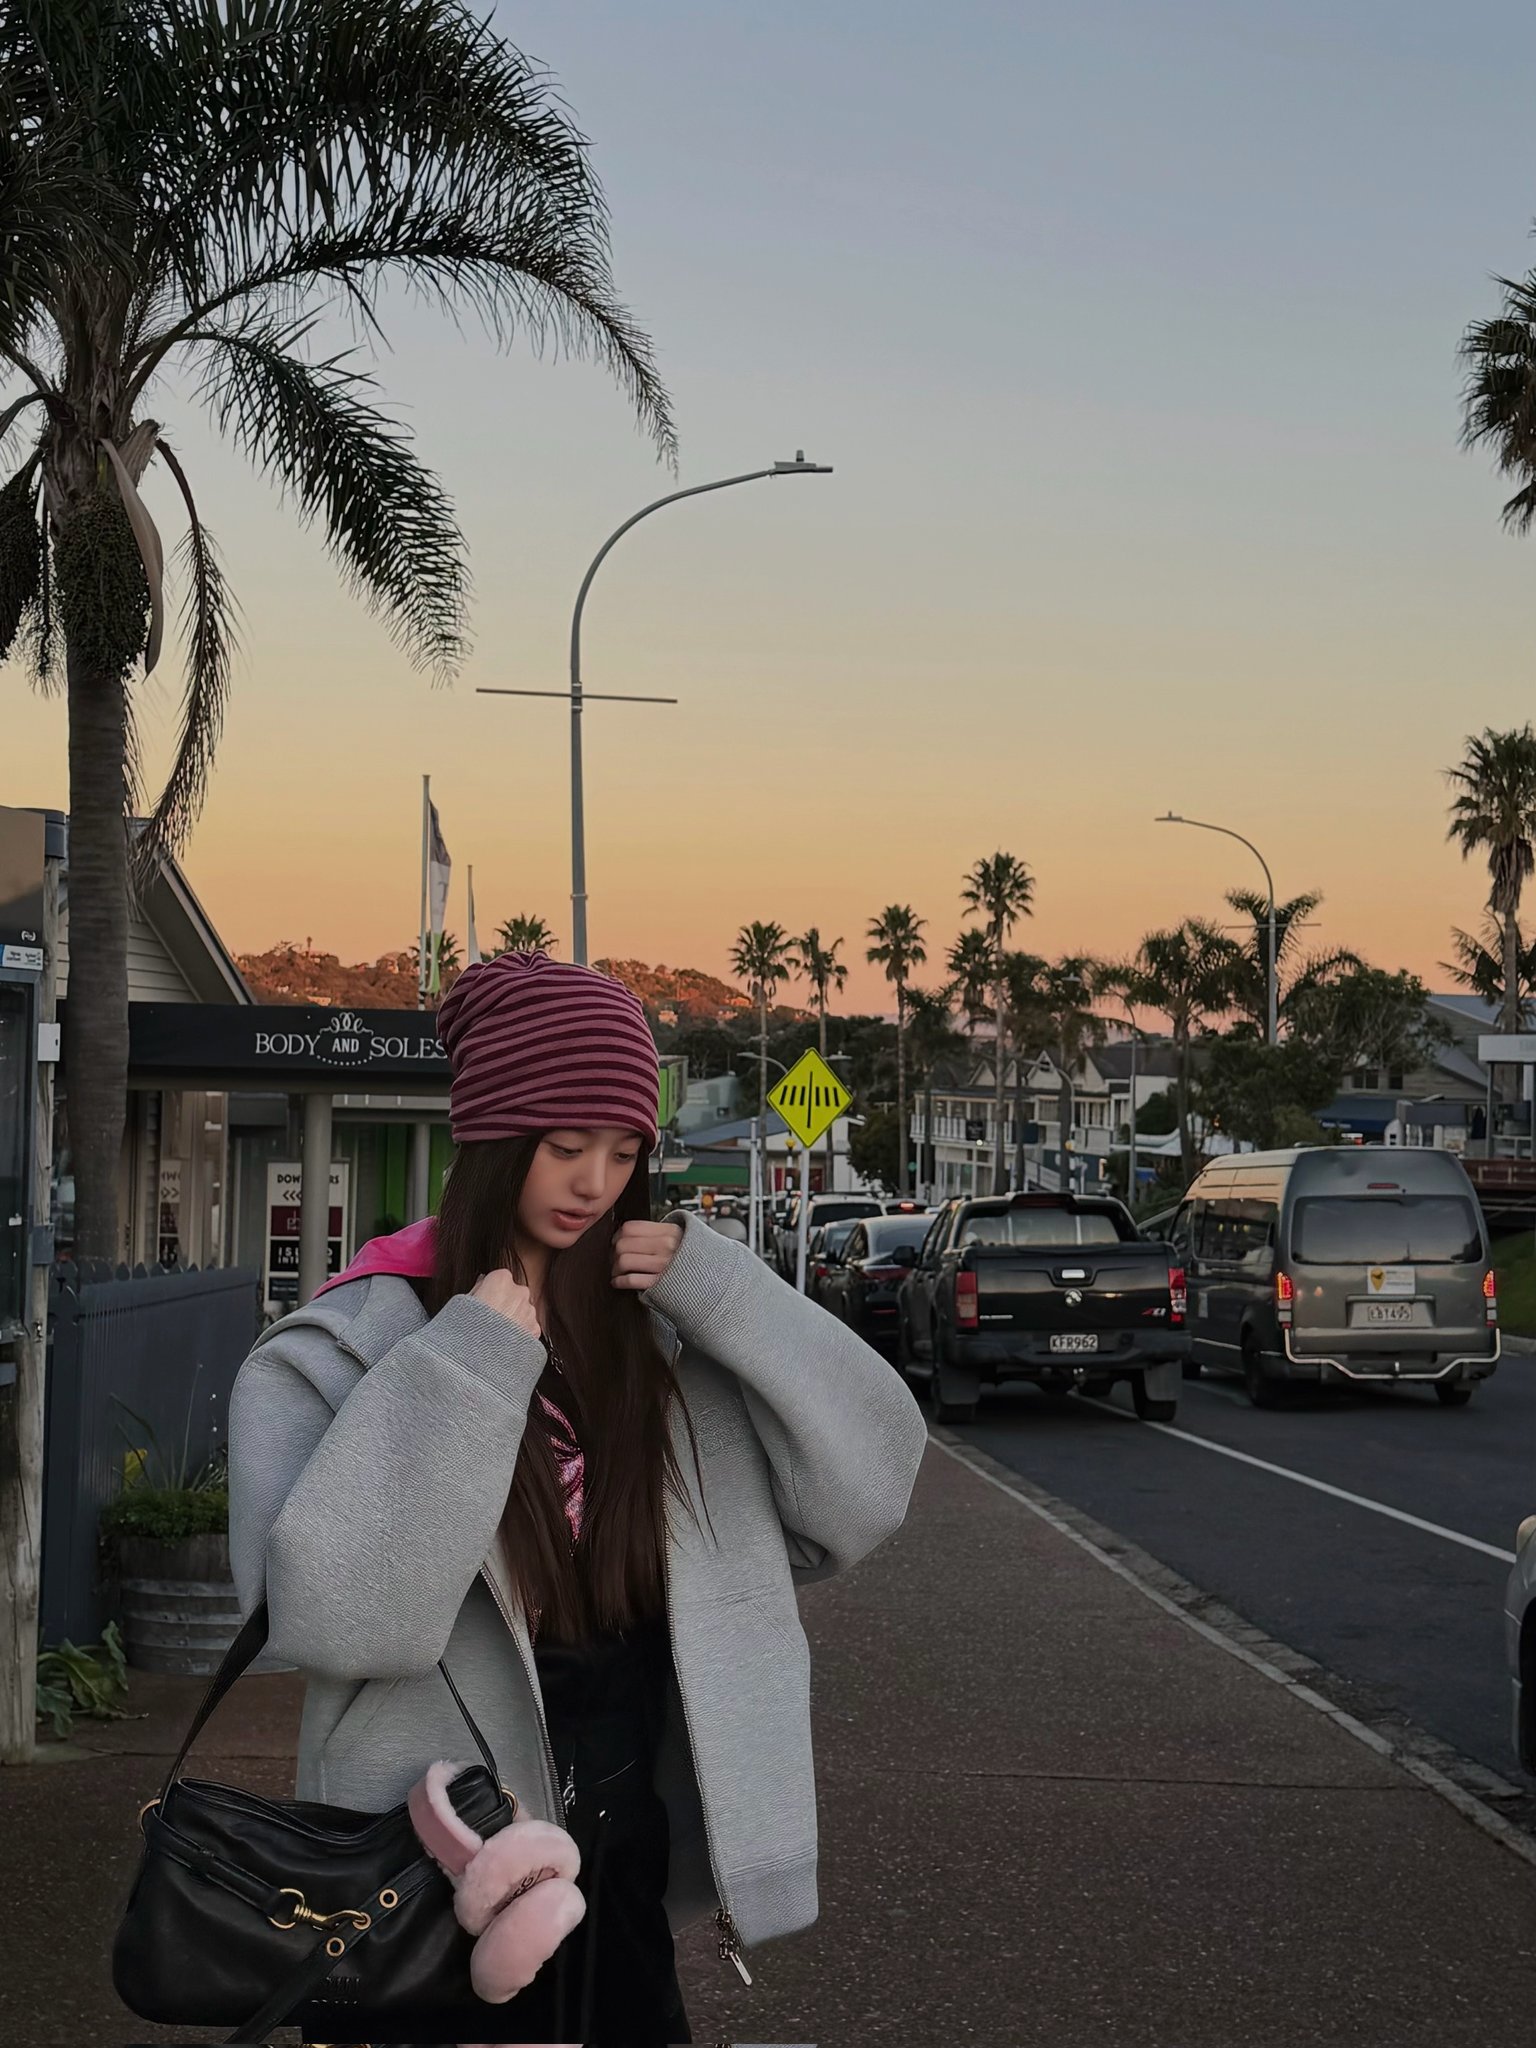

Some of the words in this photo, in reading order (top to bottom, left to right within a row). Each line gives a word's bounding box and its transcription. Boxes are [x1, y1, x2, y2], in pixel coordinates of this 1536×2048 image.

[255, 1033, 320, 1055] BODY
[331, 1038, 360, 1053] AND
[370, 1036, 448, 1059] SOLES
[1052, 1336, 1097, 1348] KFR962
